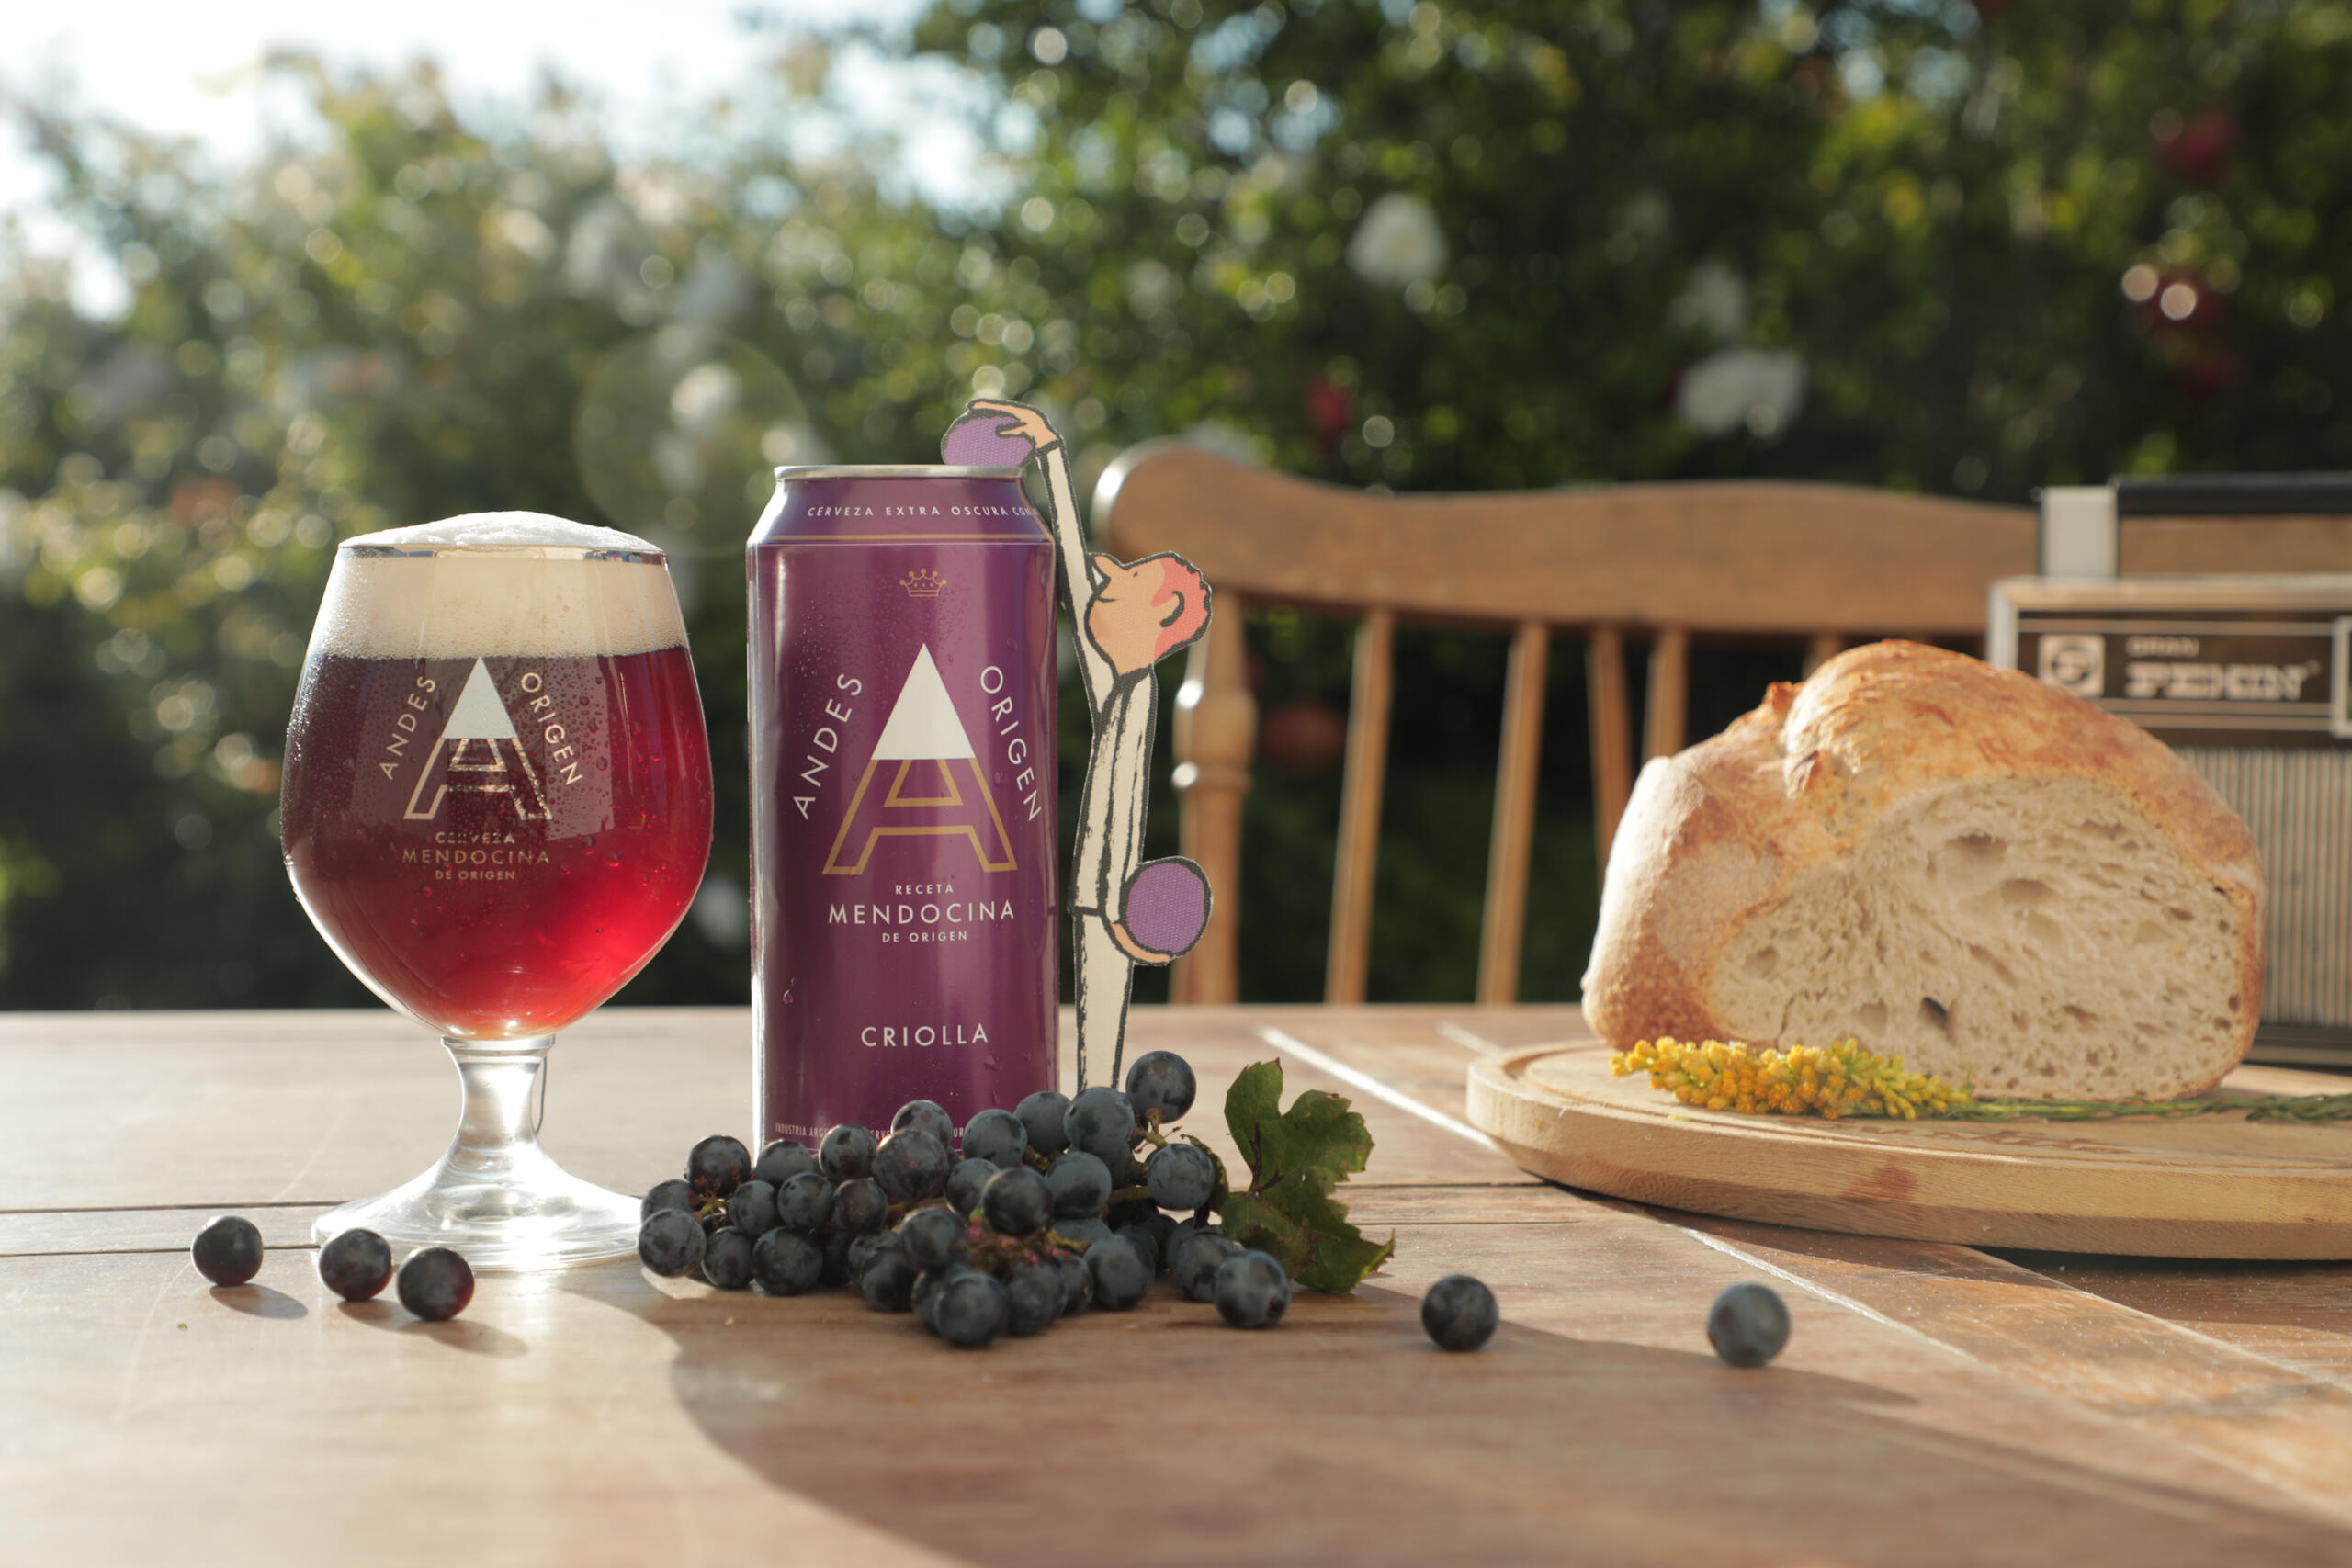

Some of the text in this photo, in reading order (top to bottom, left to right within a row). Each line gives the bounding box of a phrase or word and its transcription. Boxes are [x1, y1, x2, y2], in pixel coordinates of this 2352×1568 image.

[807, 506, 875, 517] CERVEZA
[885, 505, 940, 516] EXTRA
[951, 506, 1009, 517] OSCURA
[379, 672, 582, 785] ANDES ORIGEN
[793, 666, 1042, 822] ANDES ORIGEN
[435, 831, 515, 844] CERVEZA
[401, 849, 550, 864] MENDOCINA
[435, 870, 515, 881] DE ORIGEN
[895, 884, 955, 895] RECETA
[829, 899, 1015, 924] MENDOCINA
[882, 931, 967, 942] DE ORIGEN
[861, 1023, 989, 1047] CRIOLLA
